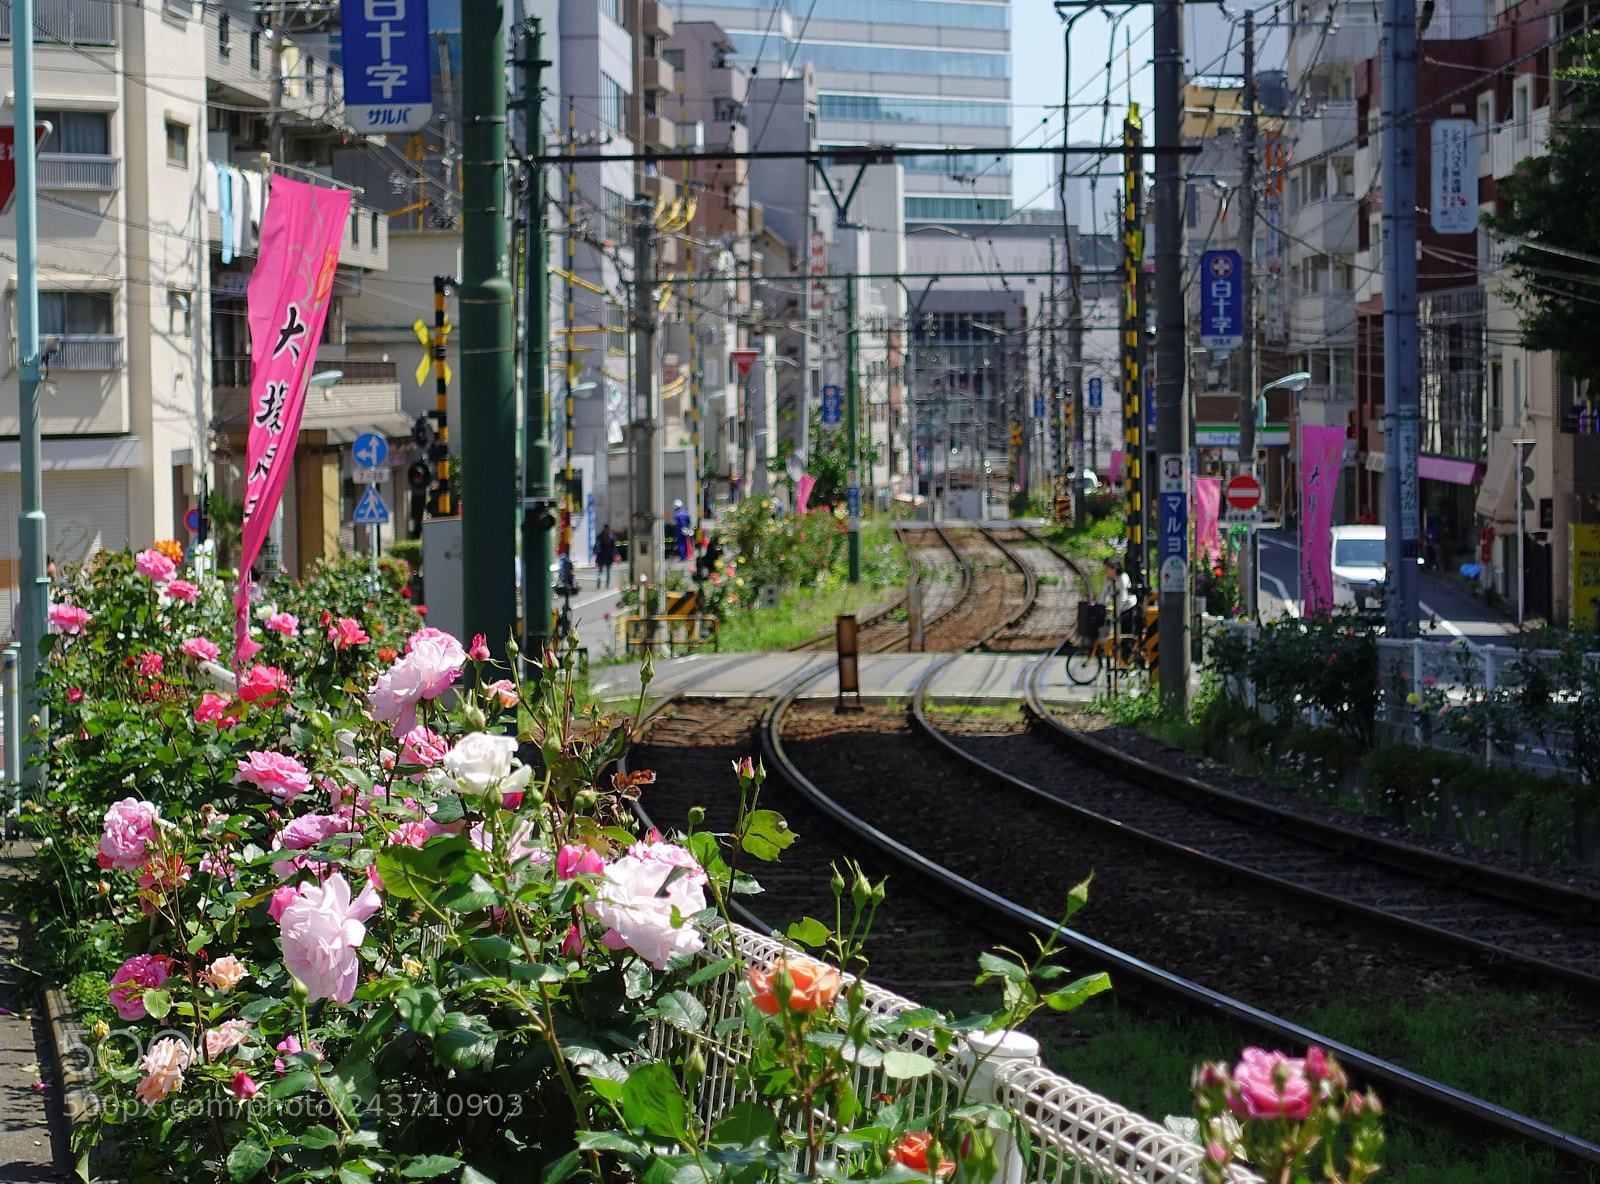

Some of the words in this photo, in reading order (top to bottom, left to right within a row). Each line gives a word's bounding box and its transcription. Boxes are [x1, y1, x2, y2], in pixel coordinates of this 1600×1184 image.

[367, 107, 411, 125] サルバ
[1211, 280, 1232, 334] 白十字
[1166, 496, 1182, 553] マルヨ
